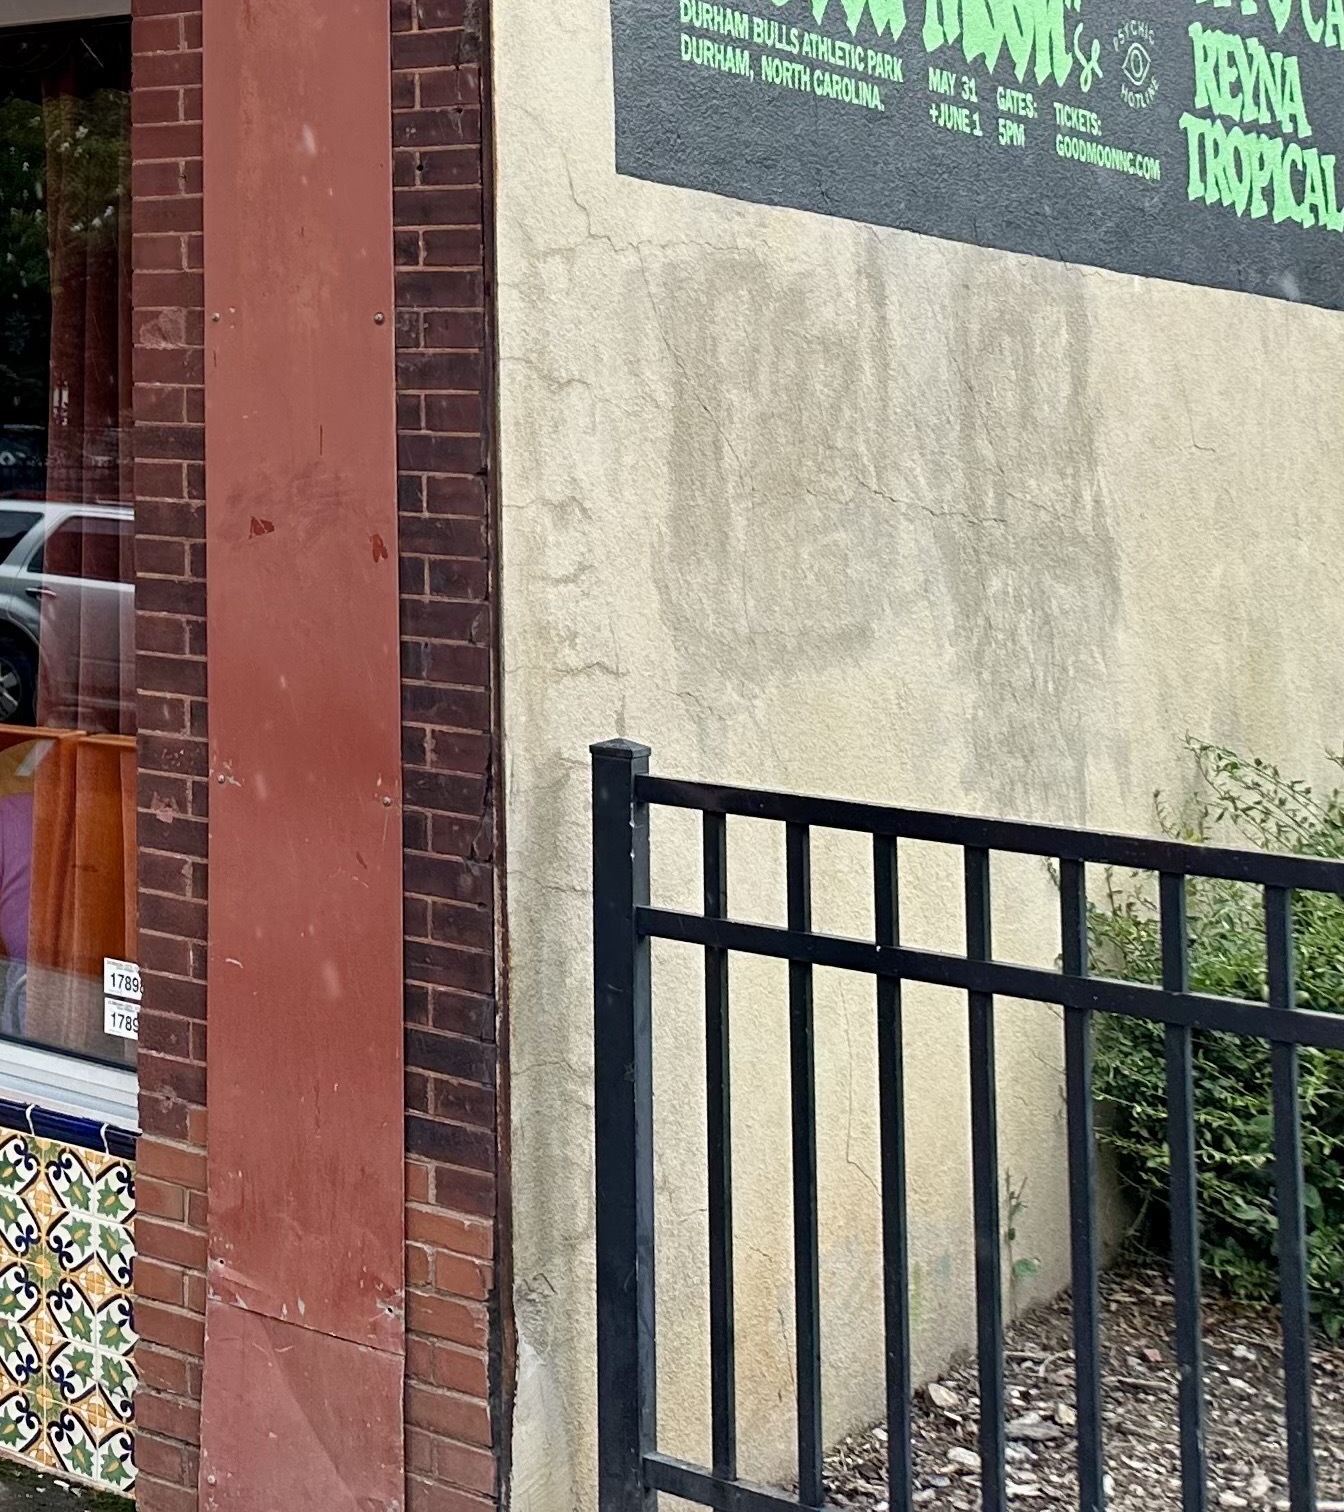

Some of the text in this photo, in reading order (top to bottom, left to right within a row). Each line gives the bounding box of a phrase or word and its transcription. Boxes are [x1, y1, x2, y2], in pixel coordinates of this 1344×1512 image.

[680, 33, 755, 83] DURHAM,
[761, 55, 811, 92] NORTH
[753, 16, 799, 55] BULLS
[802, 31, 864, 72] ATHLETIC
[867, 49, 904, 83] PARK
[928, 66, 979, 103] MAY 31
[1188, 21, 1312, 138] REYNA
[996, 86, 1038, 119] GATES:
[1053, 102, 1103, 137] TICKETS:
[972, 111, 984, 137] 1
[998, 118, 1026, 148] 5PM
[1055, 134, 1161, 181] GOODMOONNC.COM
[1178, 111, 1344, 232] TROPICAL
